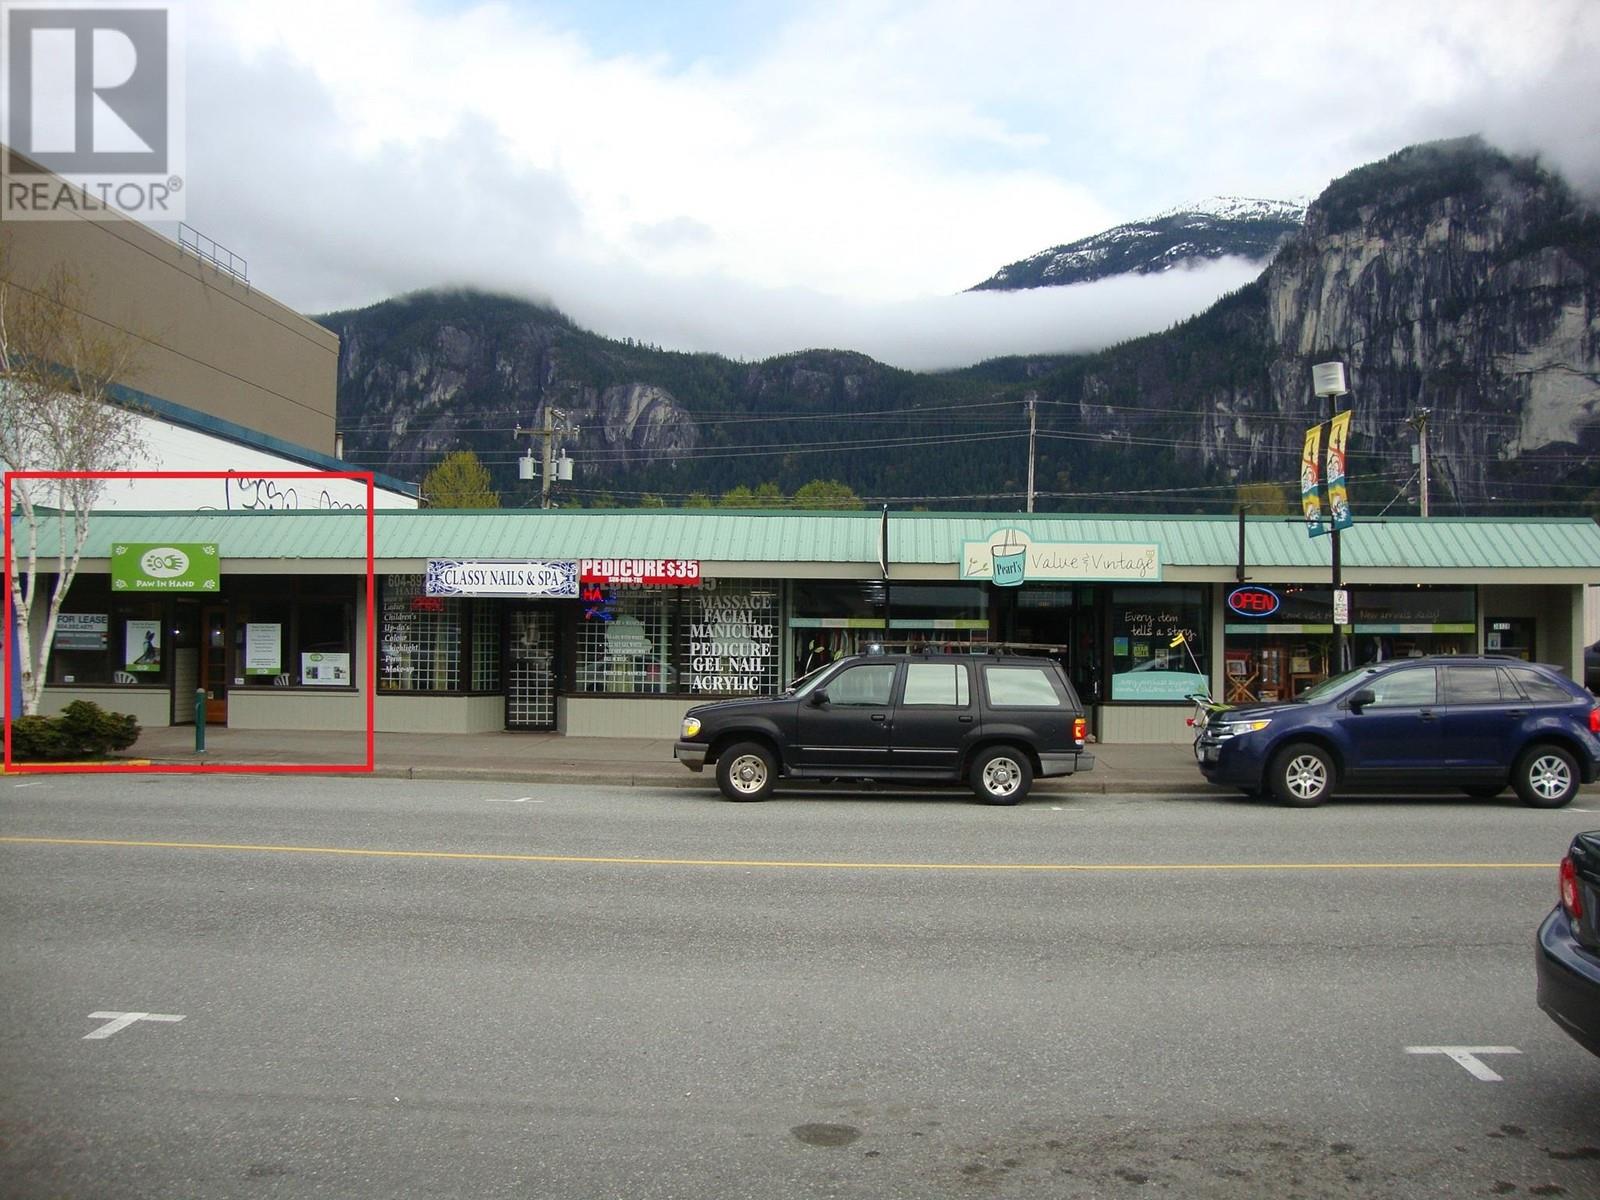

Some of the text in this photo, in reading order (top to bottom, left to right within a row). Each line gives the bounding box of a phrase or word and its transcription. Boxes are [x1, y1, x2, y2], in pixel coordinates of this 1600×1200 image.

[996, 561, 1024, 576] Pearl's
[1031, 551, 1078, 570] Value
[1092, 552, 1155, 578] Vintage
[444, 569, 559, 586] CLASSY NAILS & SPA
[699, 595, 771, 609] MASSAGE
[1231, 592, 1274, 610] OPEN
[57, 615, 107, 624] FOR LEASE
[703, 609, 756, 624] FACIAL
[1125, 611, 1155, 627] Every
[690, 624, 773, 639] MANICURE
[1131, 625, 1153, 636] tells
[690, 642, 771, 657] PEDICURE
[693, 657, 765, 672] GEL NAIL
[692, 675, 759, 690] ACRYLIC
